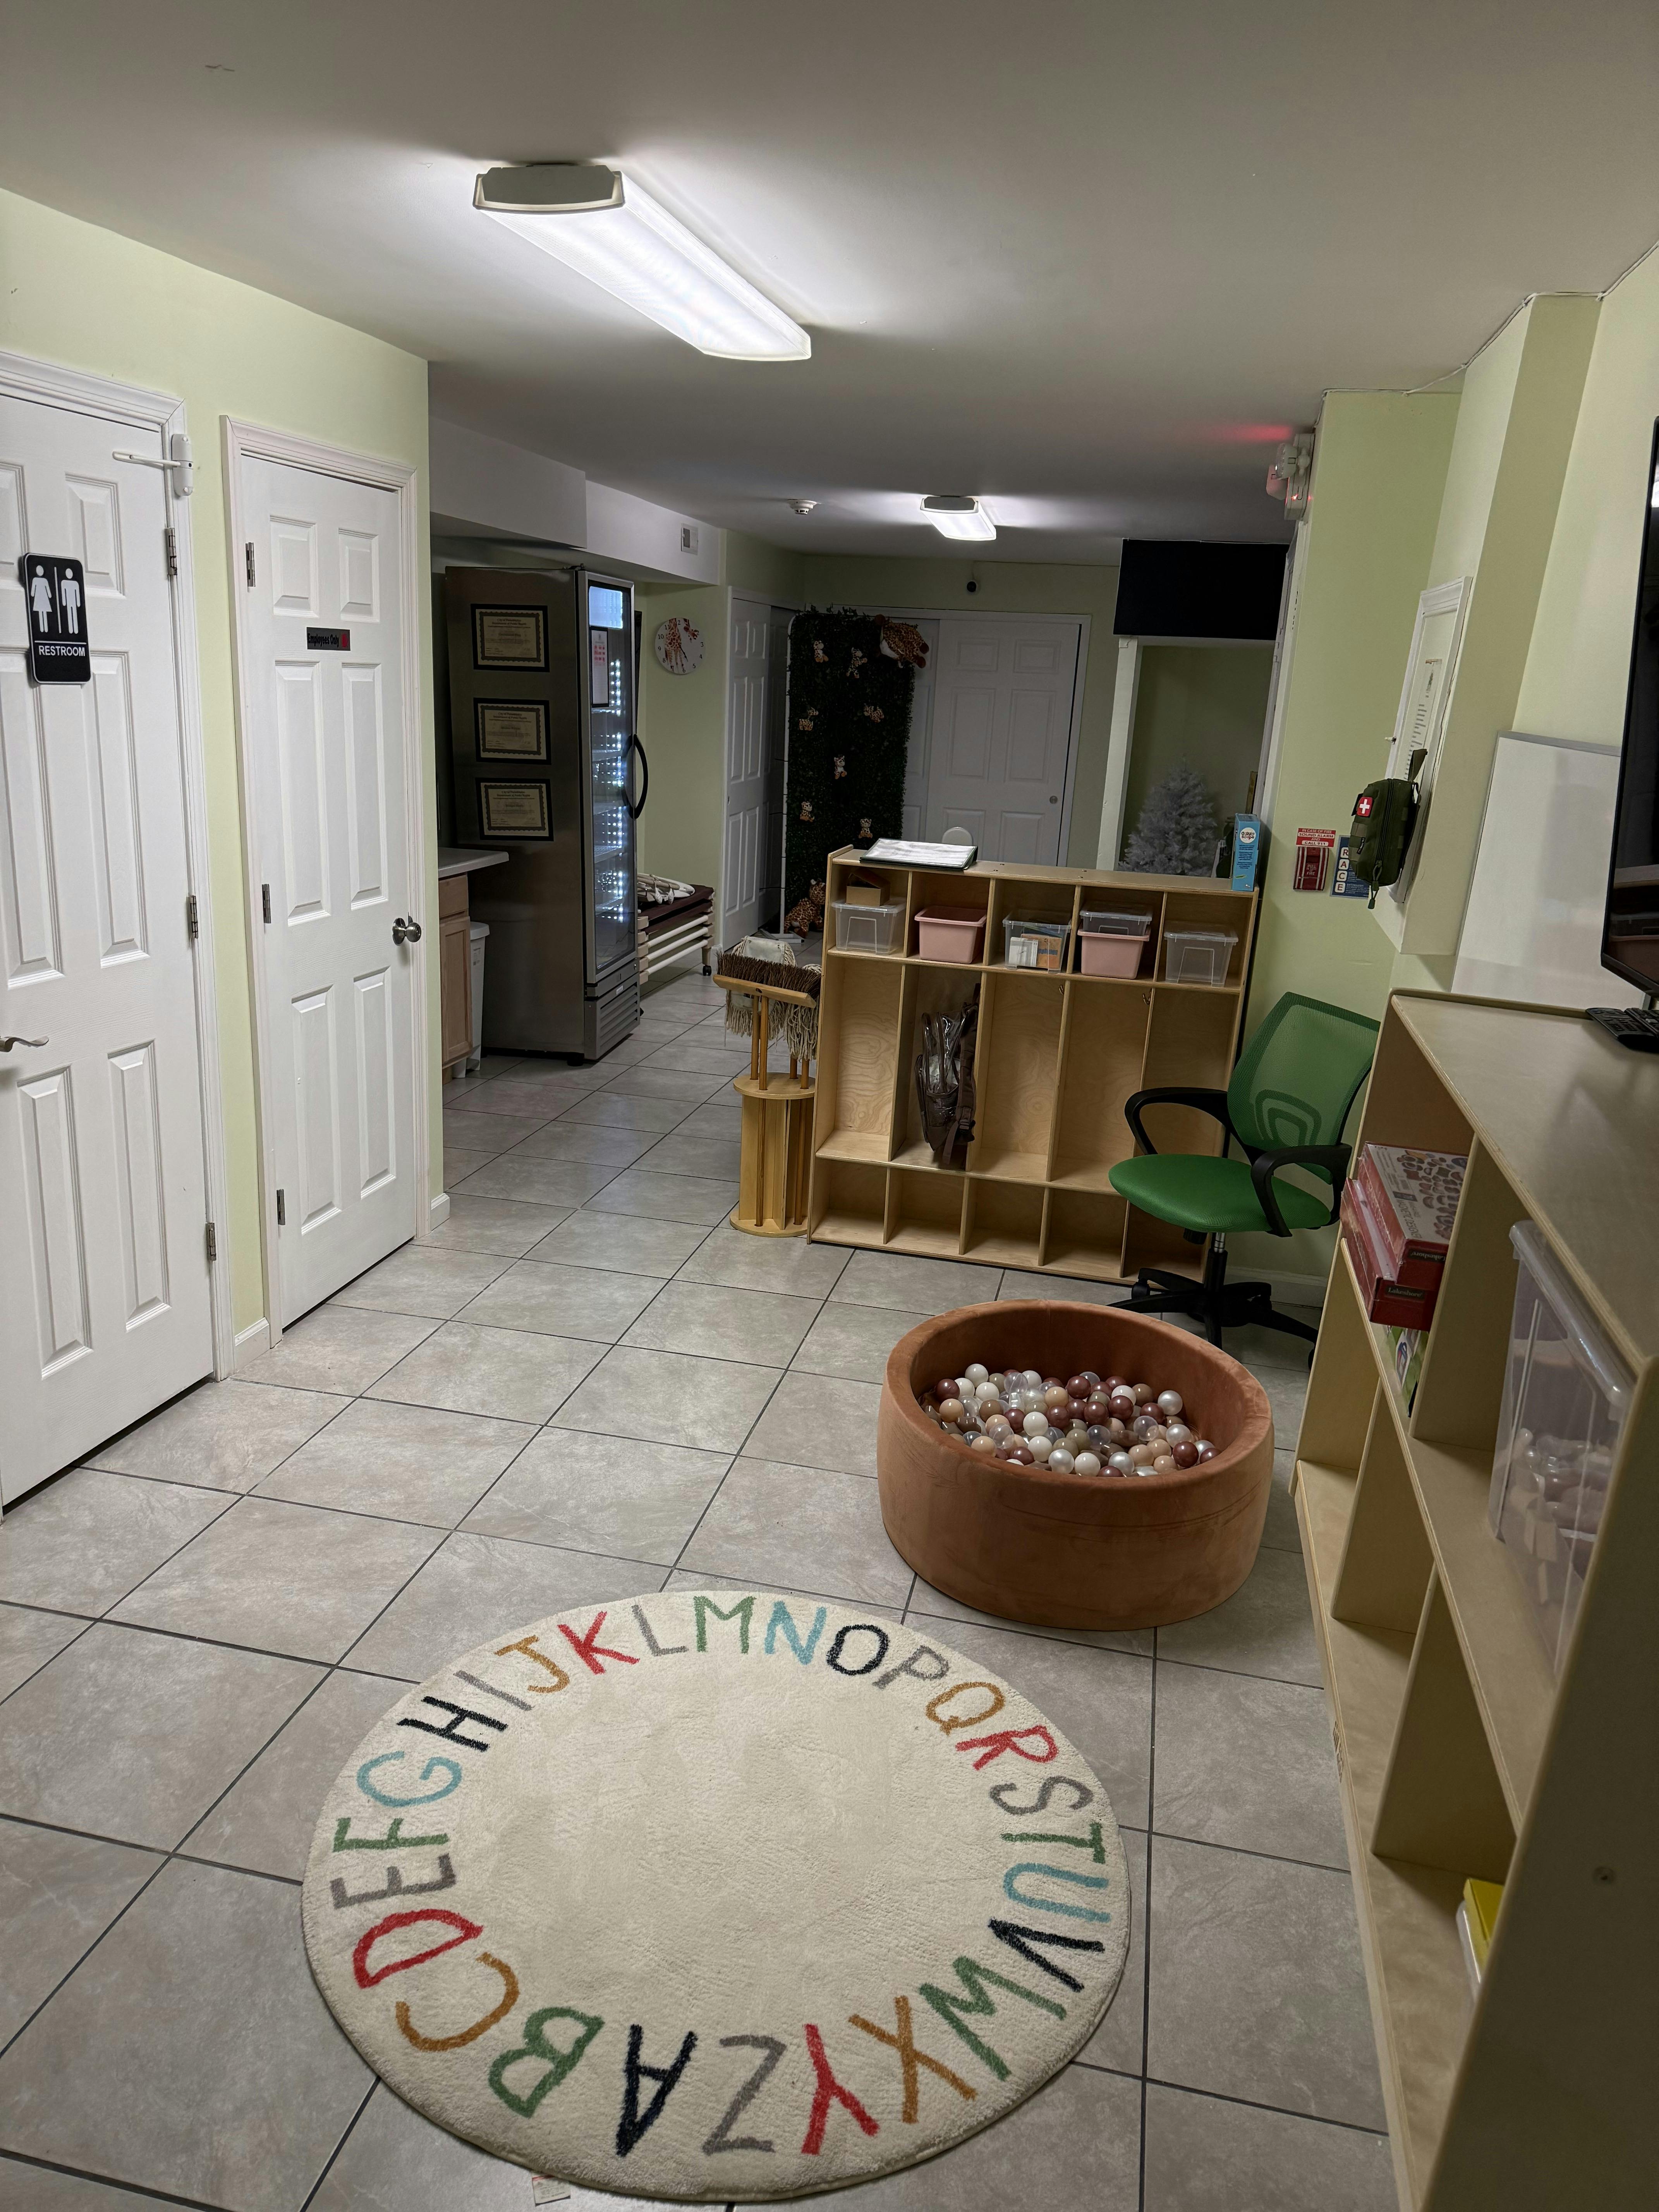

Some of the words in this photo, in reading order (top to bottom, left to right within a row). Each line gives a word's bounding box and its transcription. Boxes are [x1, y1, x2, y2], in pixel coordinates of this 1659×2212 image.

[308, 633, 329, 647] Employees
[330, 634, 339, 647] Only
[38, 645, 85, 656] RESTROOM
